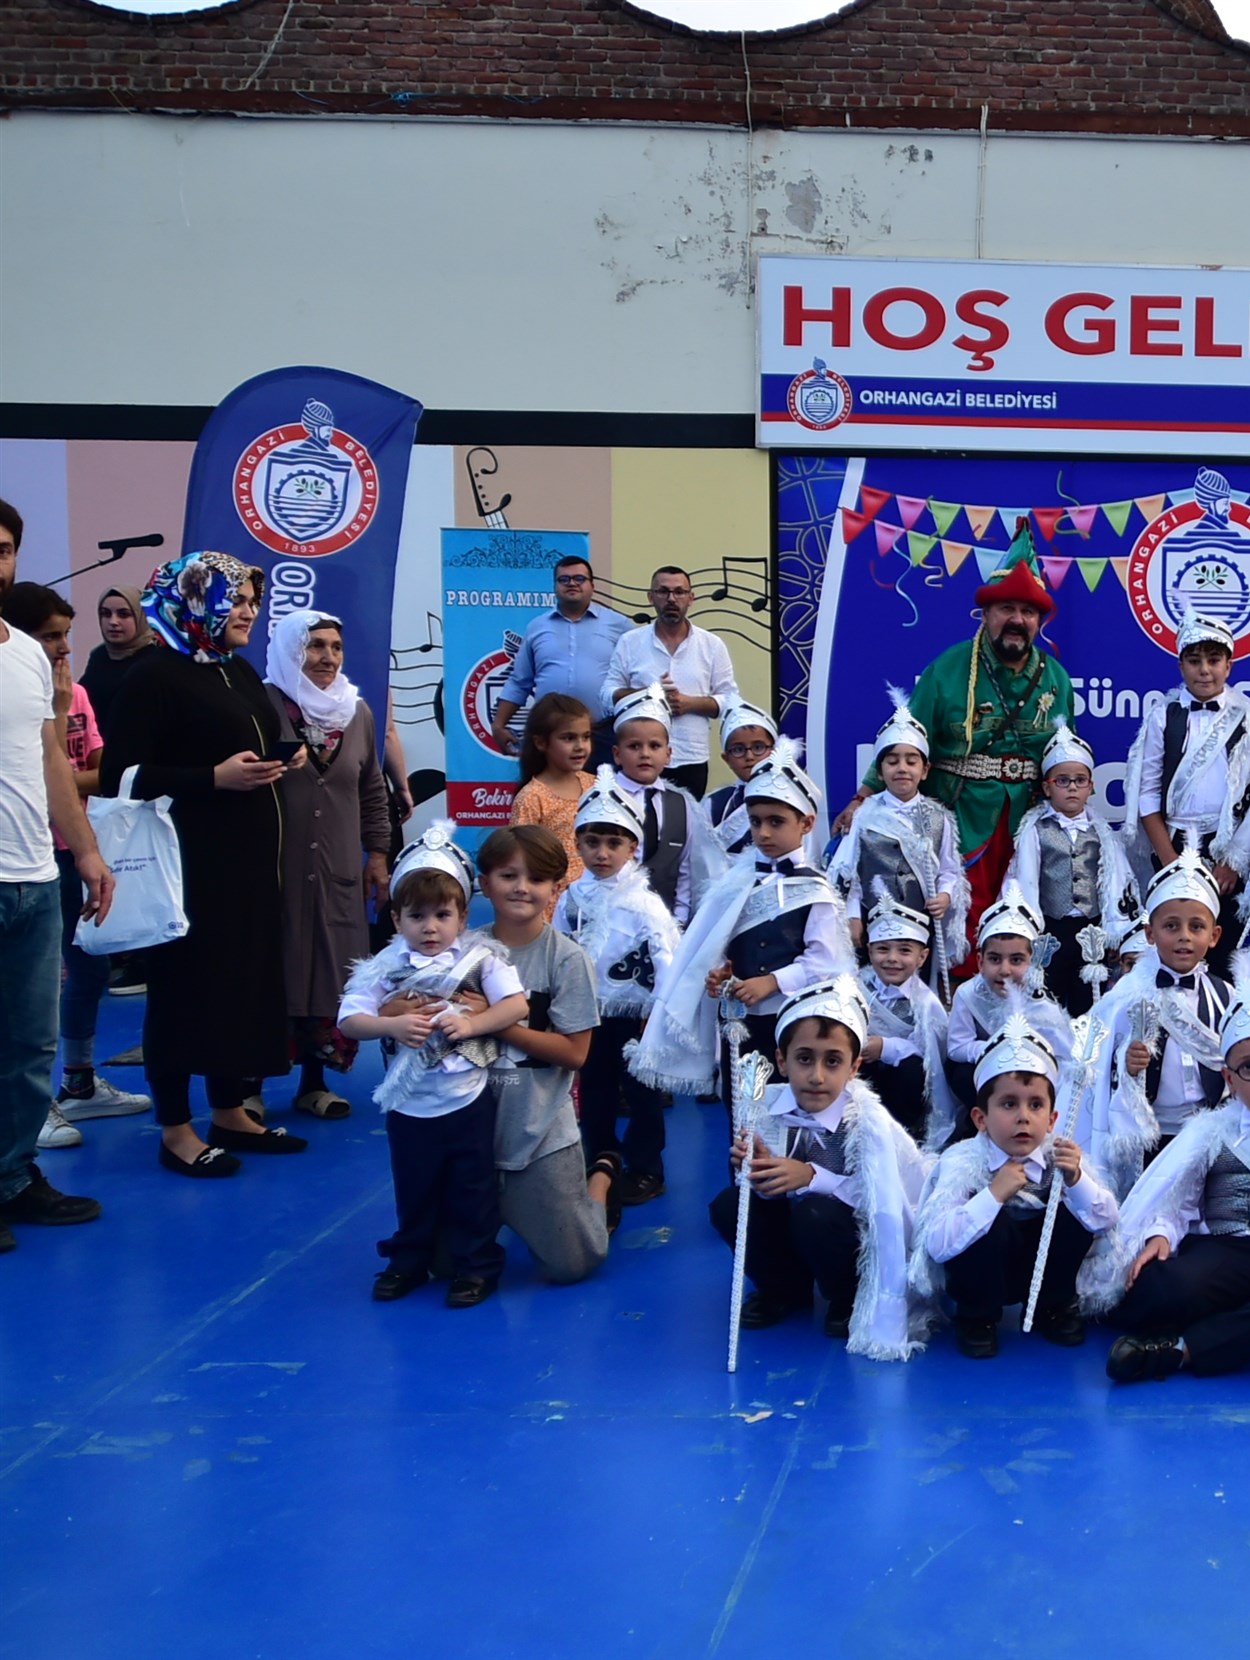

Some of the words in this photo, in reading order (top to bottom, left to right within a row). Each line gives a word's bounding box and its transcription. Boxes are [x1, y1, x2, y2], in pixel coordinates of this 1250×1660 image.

[783, 285, 1011, 372] HOŞ
[859, 389, 961, 406] ORHANGAZİ
[965, 390, 1057, 409] BELEDİYESİ
[239, 430, 285, 530] ORHANGAZİ
[344, 441, 376, 539] BELEDİYESİ
[284, 542, 316, 553] 1893
[1133, 511, 1179, 634] ORHANGAZİ
[446, 590, 557, 608] PROGRAMIM
[471, 787, 514, 808] Bekir
